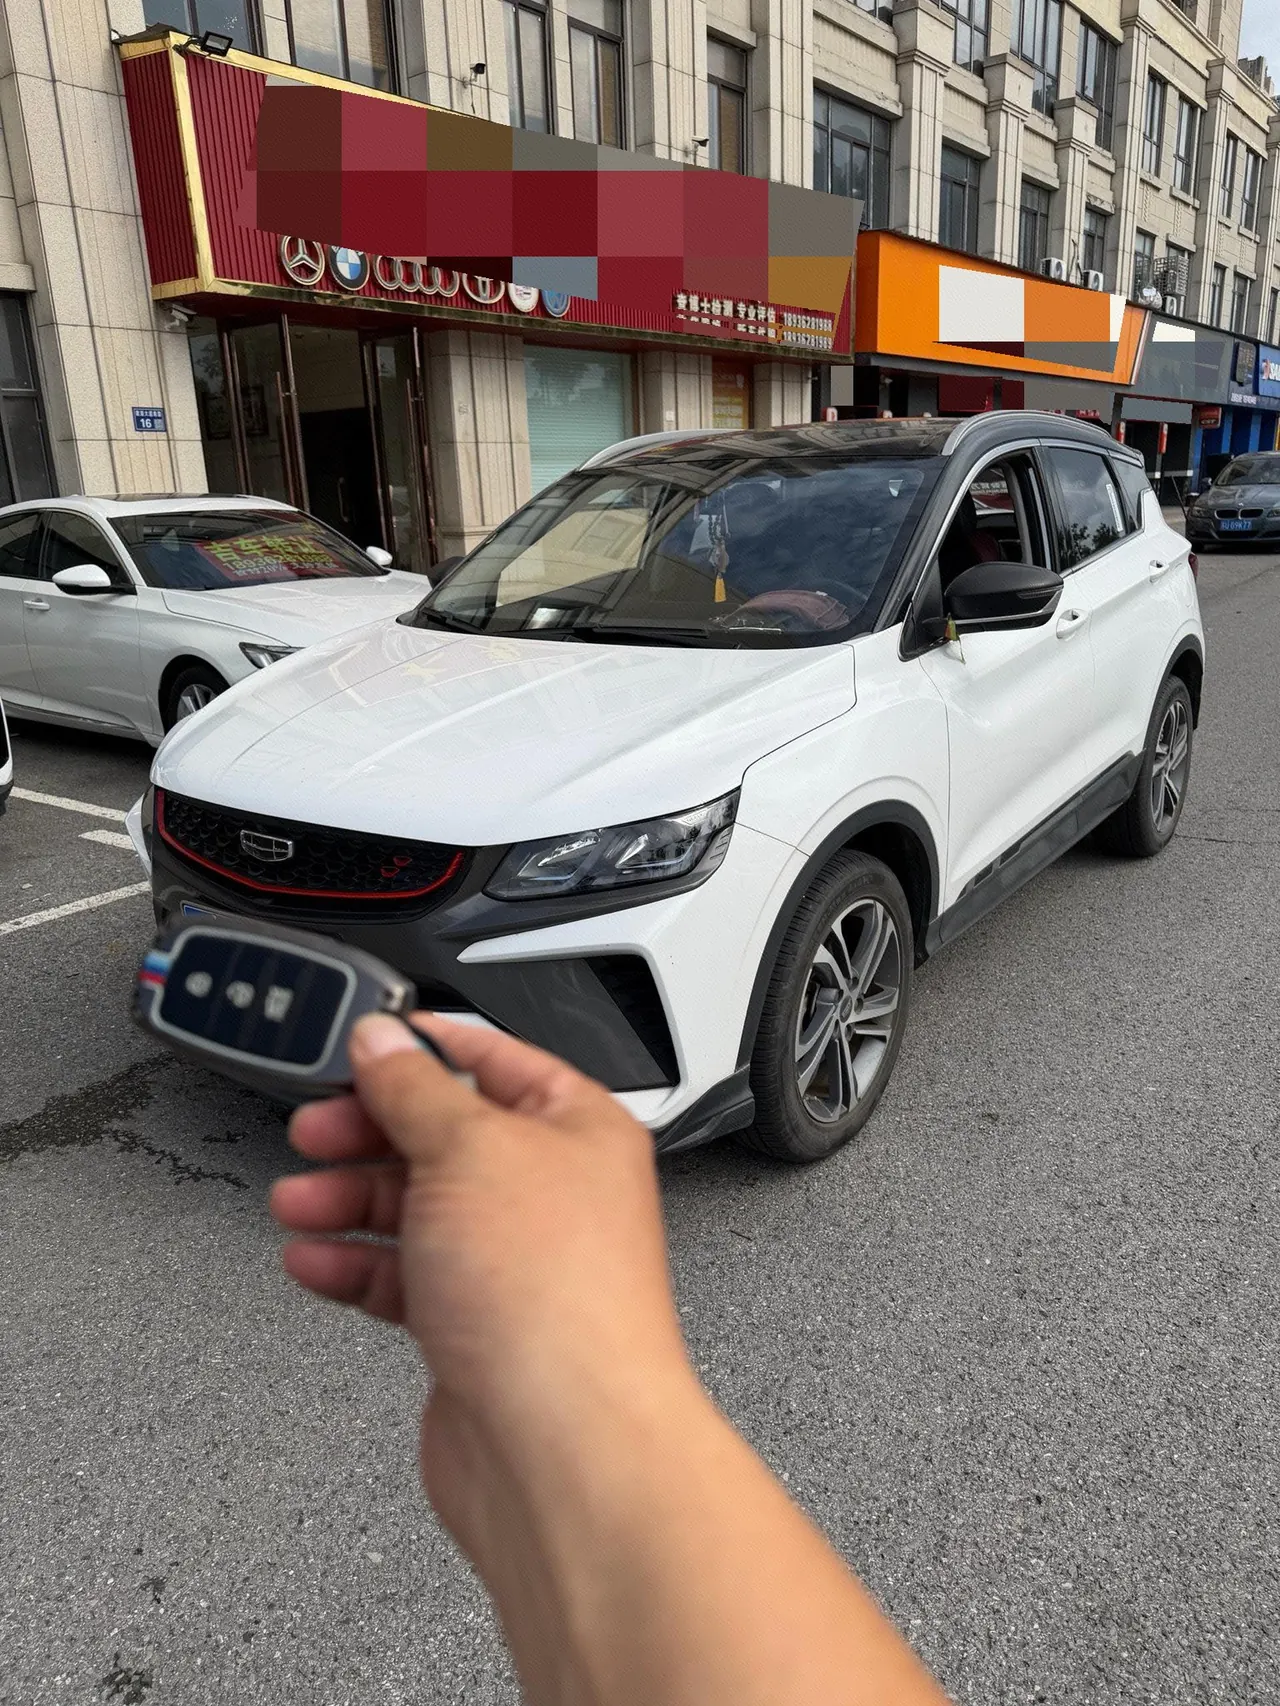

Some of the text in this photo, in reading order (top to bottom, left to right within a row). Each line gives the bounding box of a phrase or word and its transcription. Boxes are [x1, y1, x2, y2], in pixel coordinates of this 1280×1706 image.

[737, 301, 776, 323] 专业评估
[140, 418, 152, 428] 16
